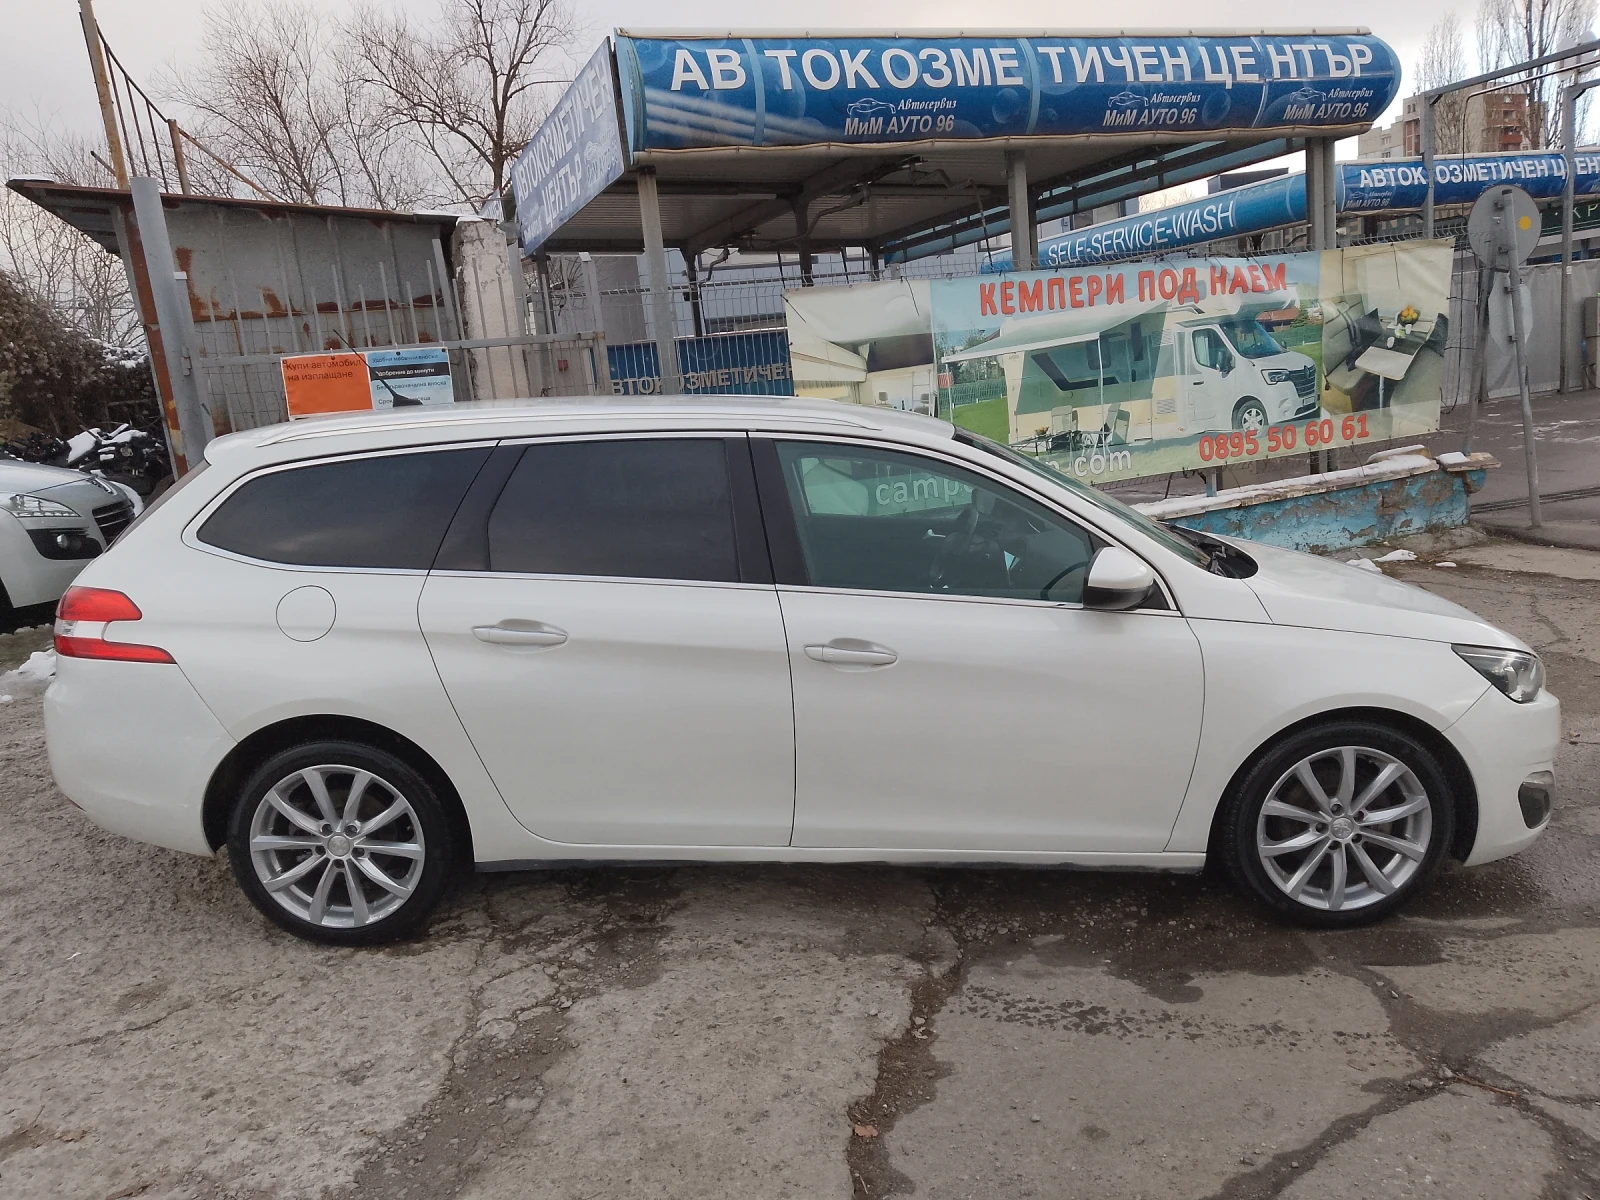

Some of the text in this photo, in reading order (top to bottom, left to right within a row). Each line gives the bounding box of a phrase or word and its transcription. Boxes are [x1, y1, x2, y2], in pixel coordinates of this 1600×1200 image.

[1150, 91, 1201, 105] Автосервиз
[1327, 87, 1374, 100] Автосервиз
[898, 97, 957, 112] Автосервиз
[1283, 102, 1369, 121] МиМ АУТО 96
[844, 115, 955, 136] МиМ АУТО 96
[1102, 107, 1198, 127] МиМ АУТО 96
[514, 56, 613, 205] АВТОКОЗМЕТИЧЕН
[1359, 156, 1600, 188] АВТОКОЗМЕТИЧЕН ЦЕН
[541, 152, 582, 229] ЦЕНТЪР
[1047, 200, 1236, 268] SELF-SERVICE-WASH
[979, 262, 1288, 316] КЕМПЕРИ ПОД НАЕМ
[286, 358, 362, 371] Купи автомобил
[302, 371, 354, 380] изплащане
[1199, 413, 1370, 461] 0895 50 60 61
